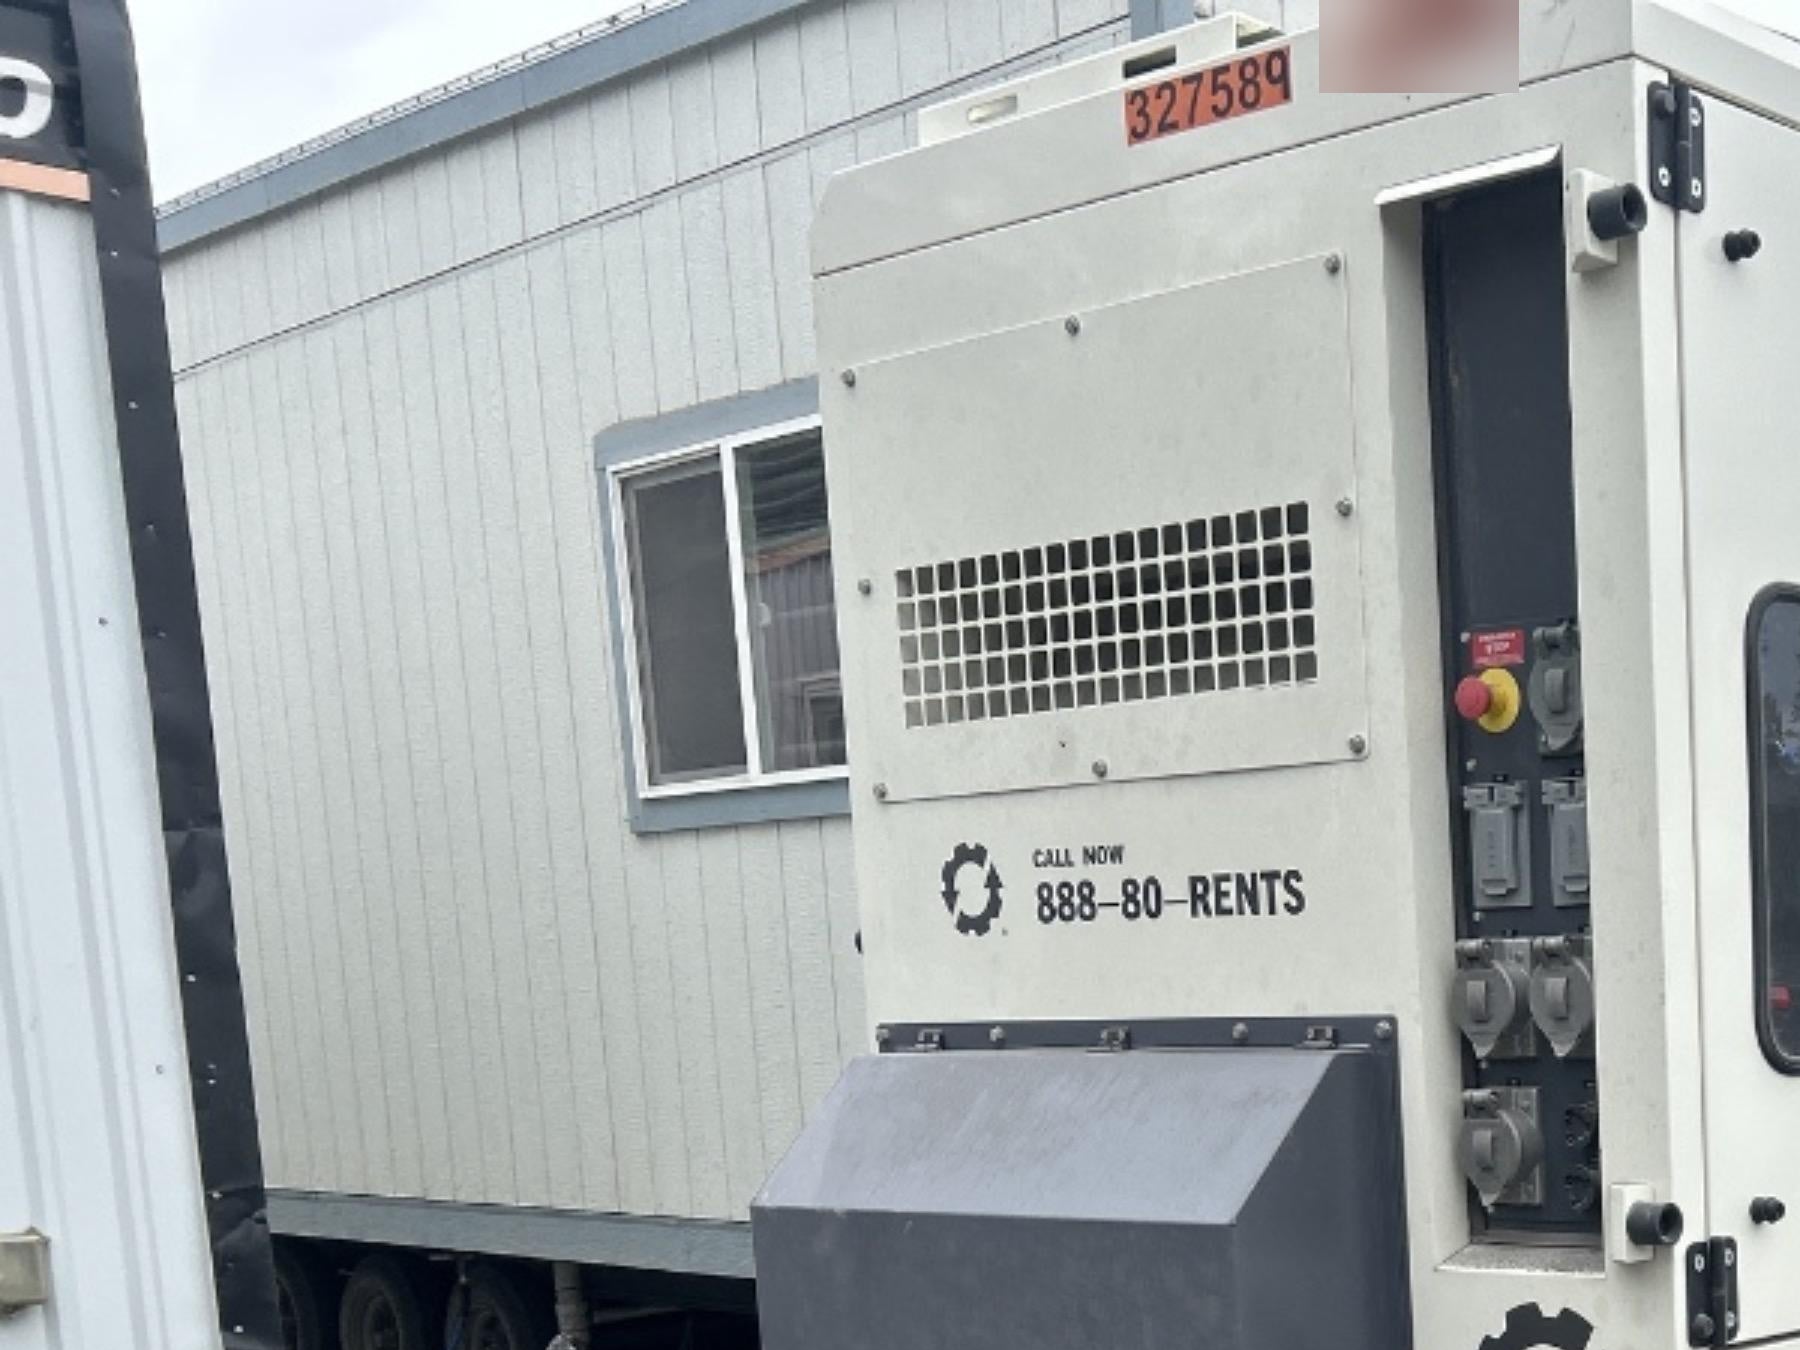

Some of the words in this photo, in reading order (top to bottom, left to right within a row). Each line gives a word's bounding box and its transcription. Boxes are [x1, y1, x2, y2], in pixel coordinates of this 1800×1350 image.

[1128, 50, 1292, 140] 327589
[1032, 847, 1075, 868] CALL
[1082, 844, 1125, 866] NOW
[1036, 869, 1307, 924] 888-80-RENTS
